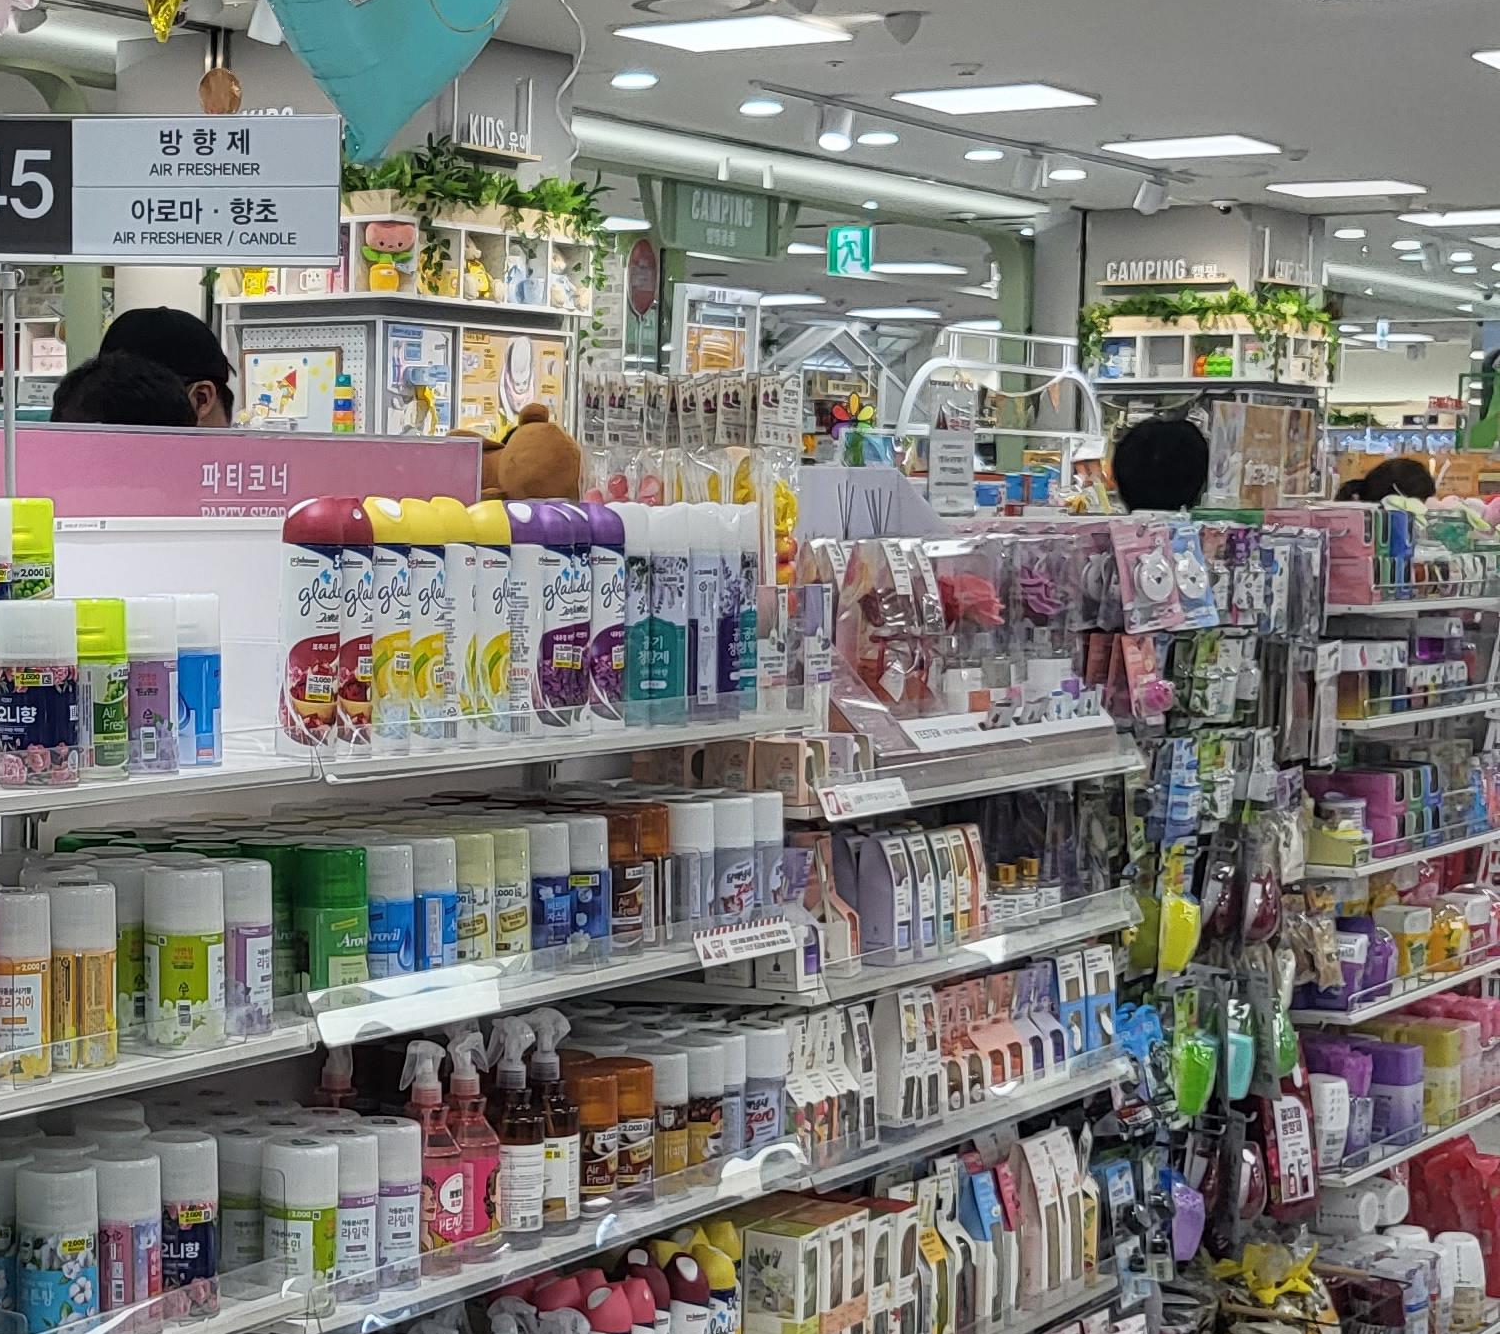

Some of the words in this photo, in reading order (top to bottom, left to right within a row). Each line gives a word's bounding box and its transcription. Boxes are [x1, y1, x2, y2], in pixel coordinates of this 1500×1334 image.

[469, 113, 505, 150] KIDS
[148, 161, 172, 177] AIR
[174, 161, 261, 178] FRESHENER
[130, 197, 204, 225] 아로마
[227, 196, 279, 225] 향초
[112, 231, 136, 246] AIR
[138, 231, 223, 247] FRESHENER
[238, 230, 297, 247] CANDLE
[1105, 258, 1187, 282] CAMPING
[201, 461, 288, 495] 파티코너
[102, 707, 117, 720] Air
